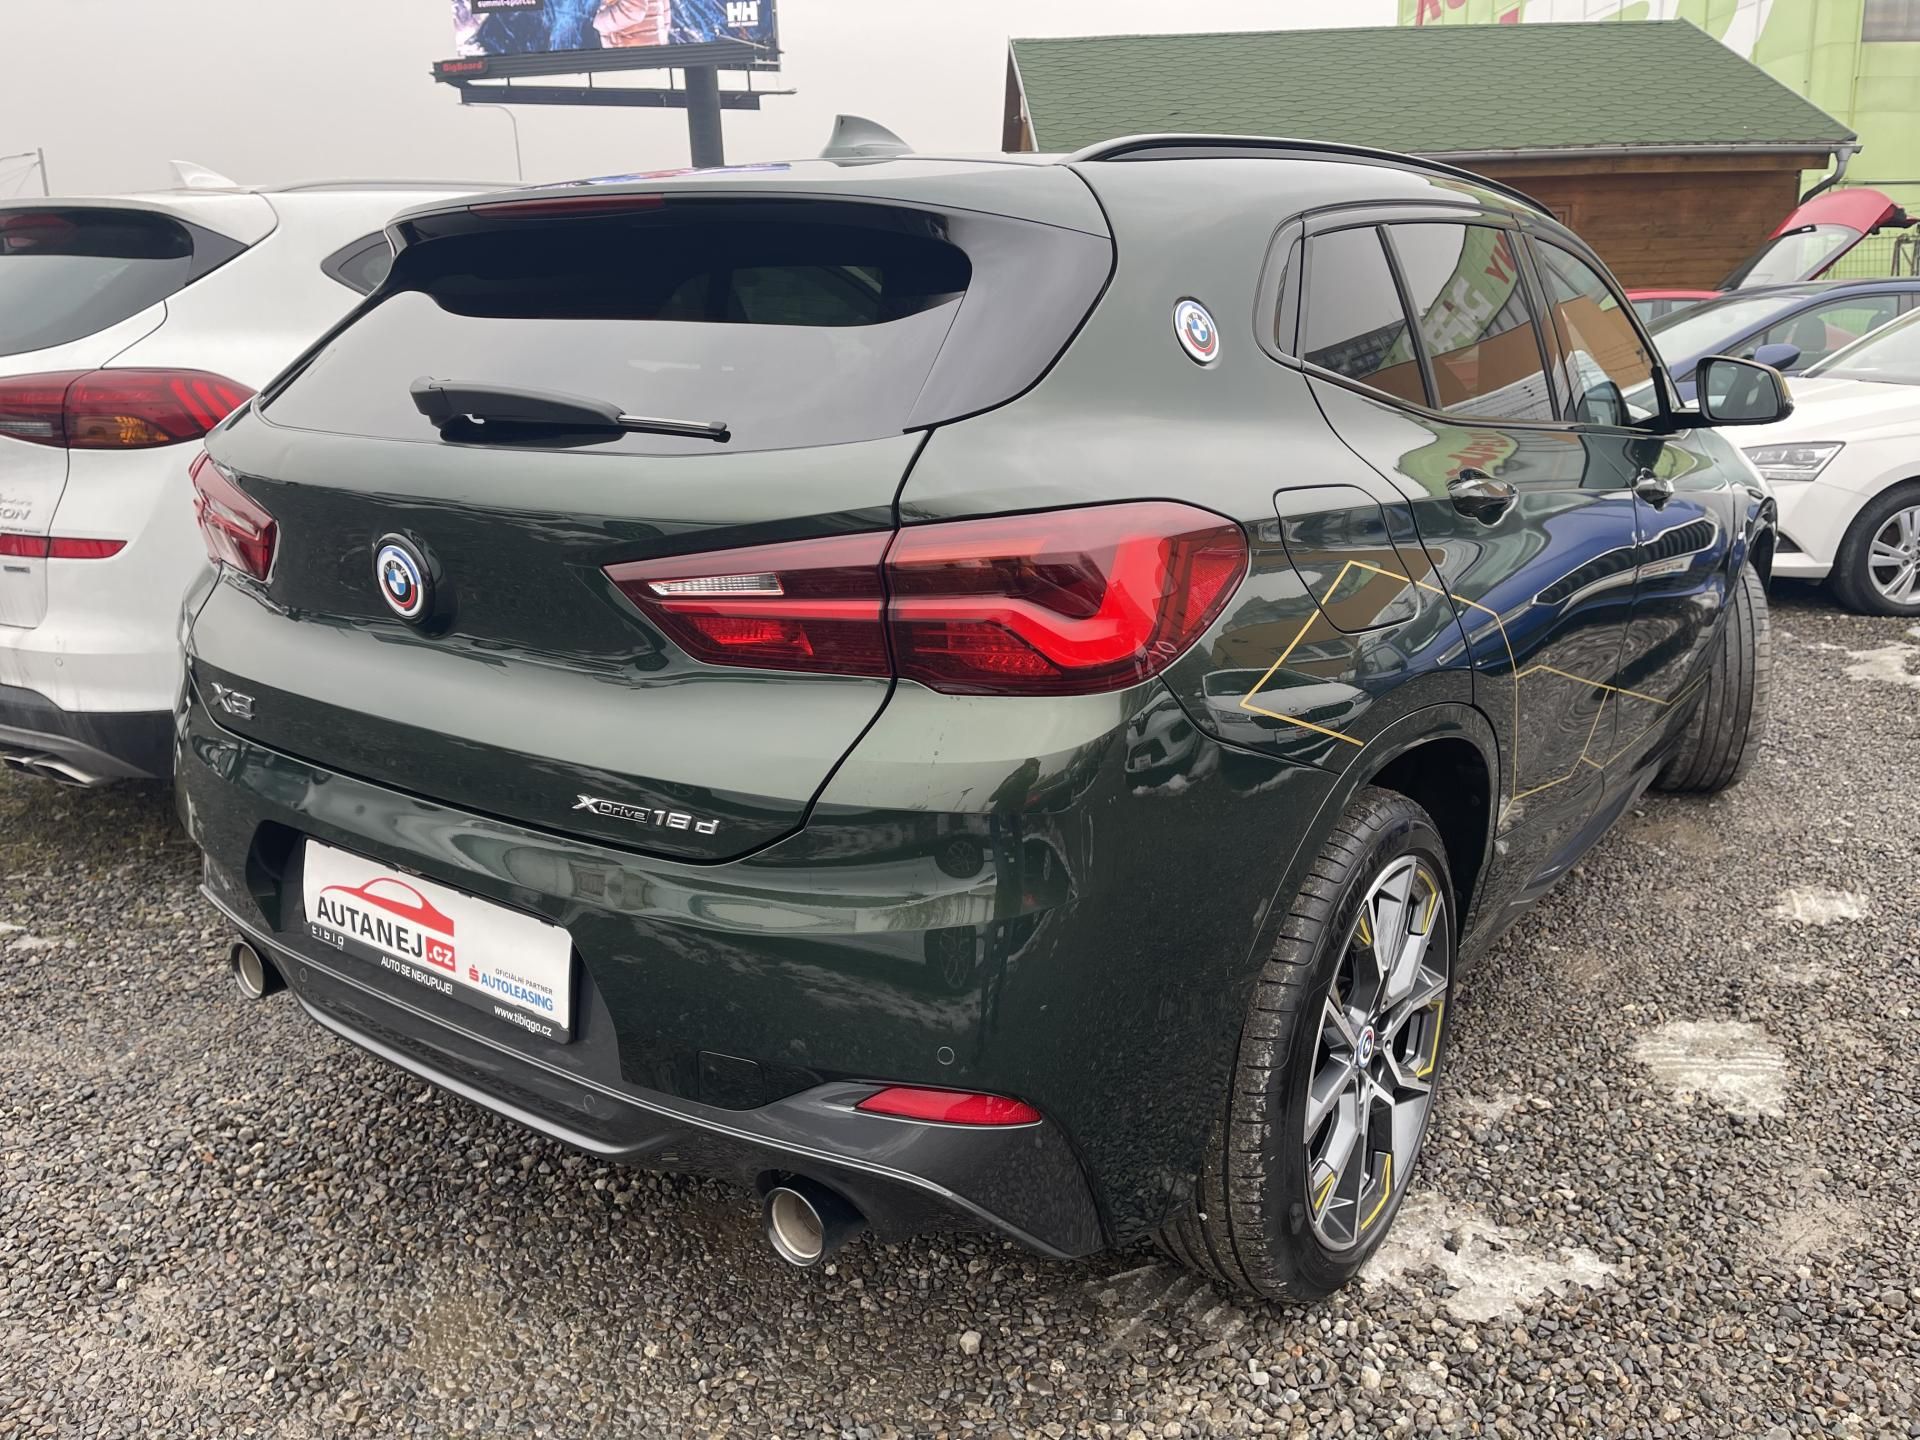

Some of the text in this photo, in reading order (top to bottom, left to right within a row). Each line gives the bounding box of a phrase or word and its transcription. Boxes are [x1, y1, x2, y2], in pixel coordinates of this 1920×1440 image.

[726, 1, 758, 21] HH
[381, 956, 453, 995] AUTO SE NEKUPUJE!
[525, 979, 553, 995] PARTNER
[481, 972, 553, 1011] AUTOLEASING
